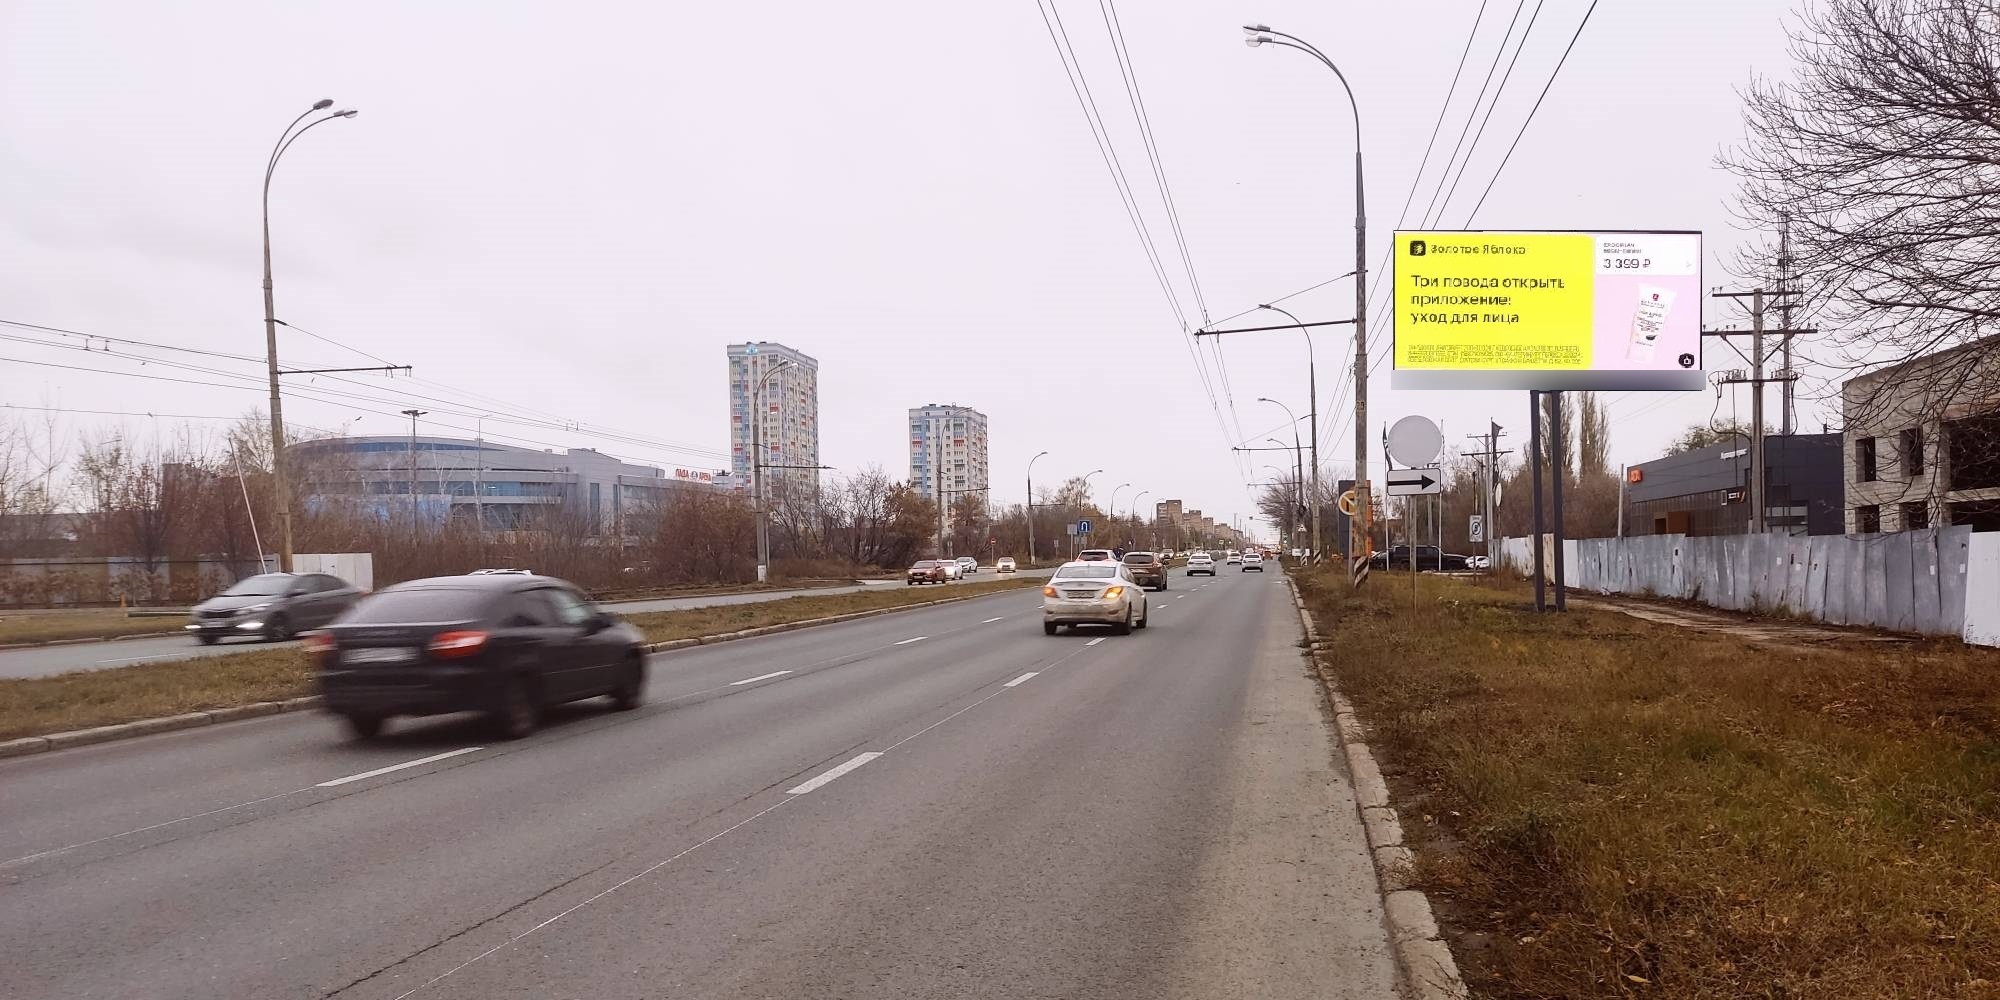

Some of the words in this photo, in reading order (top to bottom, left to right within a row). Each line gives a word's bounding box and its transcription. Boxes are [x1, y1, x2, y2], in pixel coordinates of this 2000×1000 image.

[1430, 244, 1480, 255] Золотое
[1483, 244, 1526, 255] Яблоко
[1615, 258, 1640, 269] 399
[1411, 274, 1439, 289] Три
[1443, 276, 1499, 290] повода
[1502, 277, 1565, 291] открыть
[1410, 294, 1512, 307] приложение:
[1410, 312, 1447, 325] уход
[1450, 312, 1478, 325] для
[1482, 312, 1520, 325] лица
